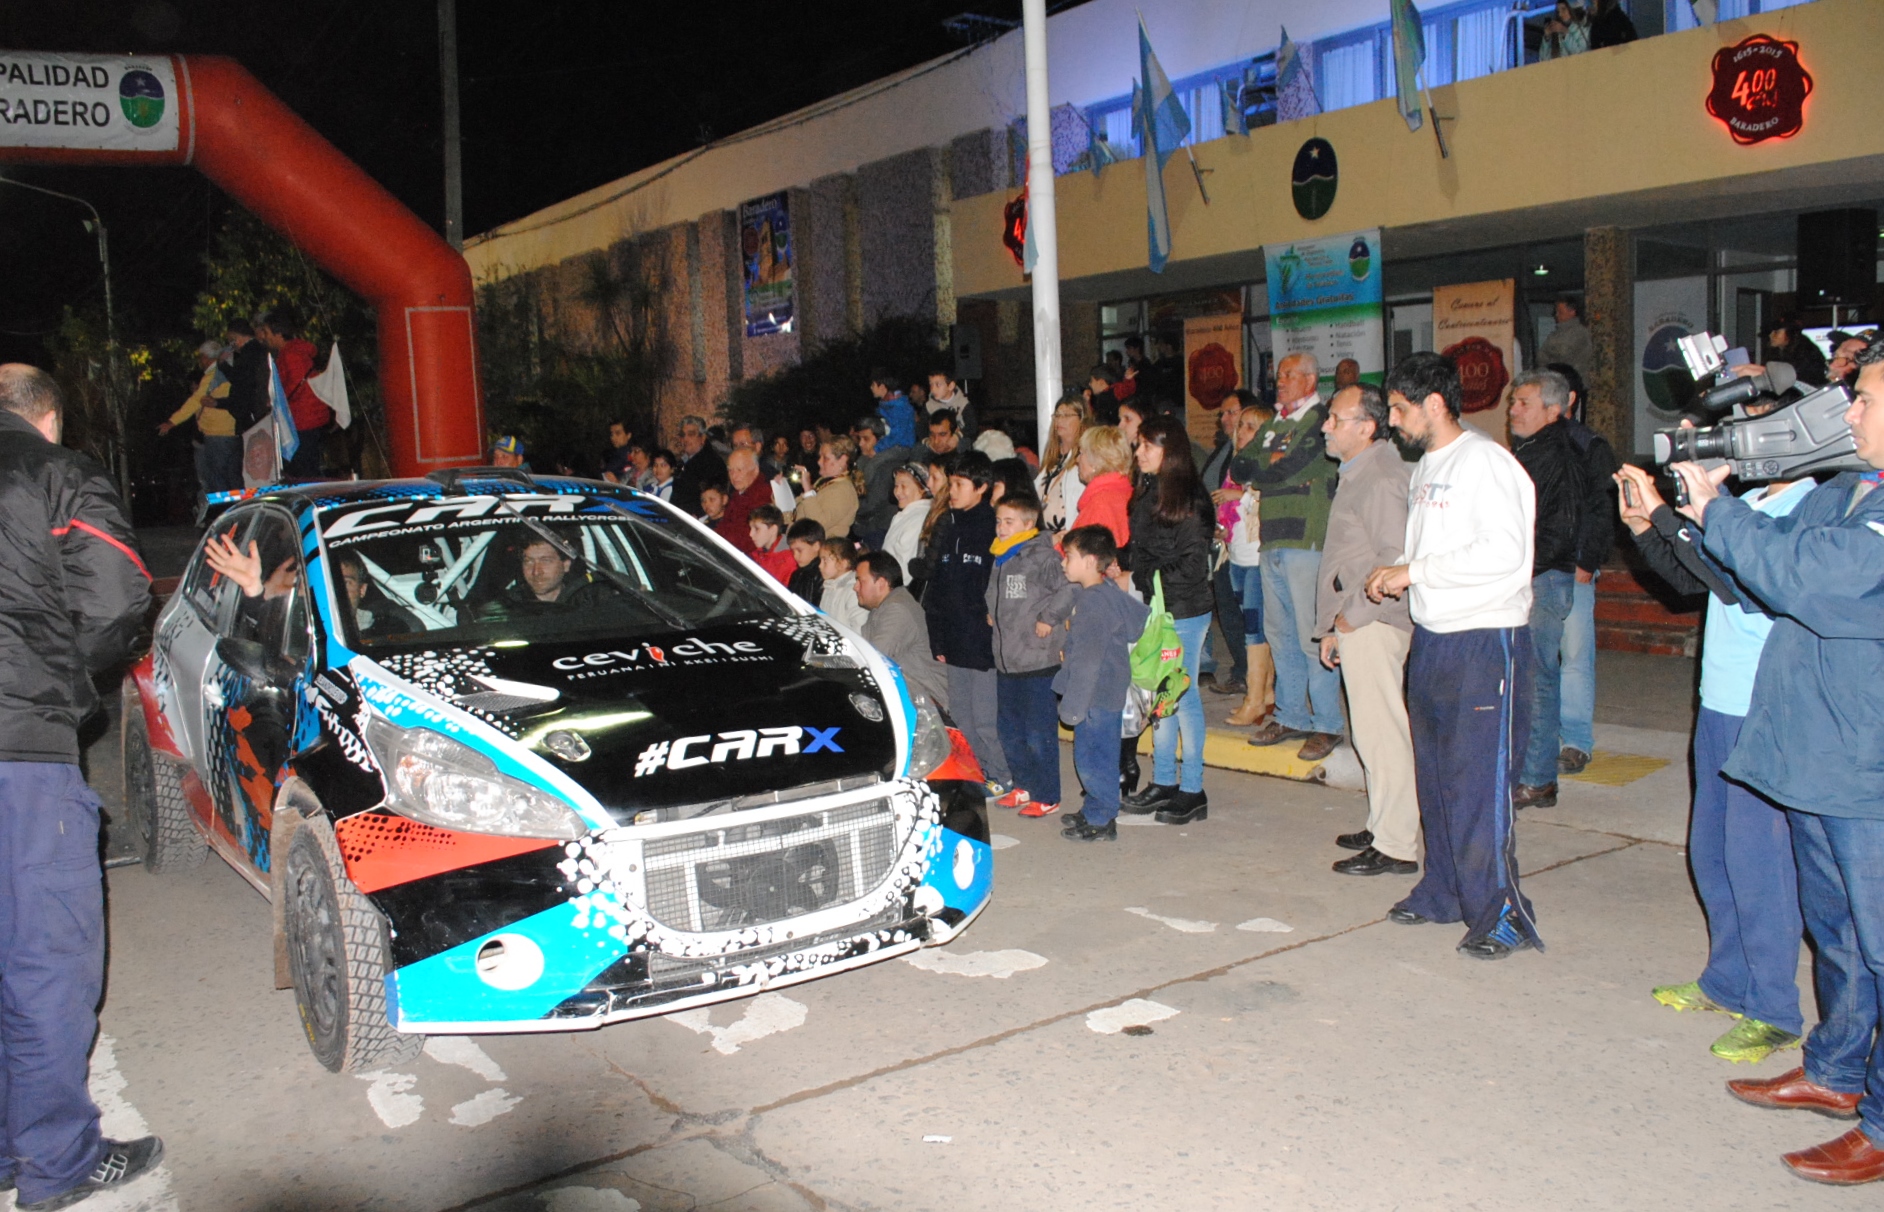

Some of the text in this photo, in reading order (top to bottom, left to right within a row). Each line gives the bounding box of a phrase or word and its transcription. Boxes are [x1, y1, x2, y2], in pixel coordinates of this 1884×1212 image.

[1733, 45, 1783, 63] 1615-2015
[0, 99, 110, 127] RADERO
[1729, 116, 1779, 132] BARADERO
[328, 522, 445, 549] CAMPEONATO
[552, 637, 764, 671] ceviche
[567, 664, 645, 681] PERUANA
[634, 725, 846, 778] #CARX
